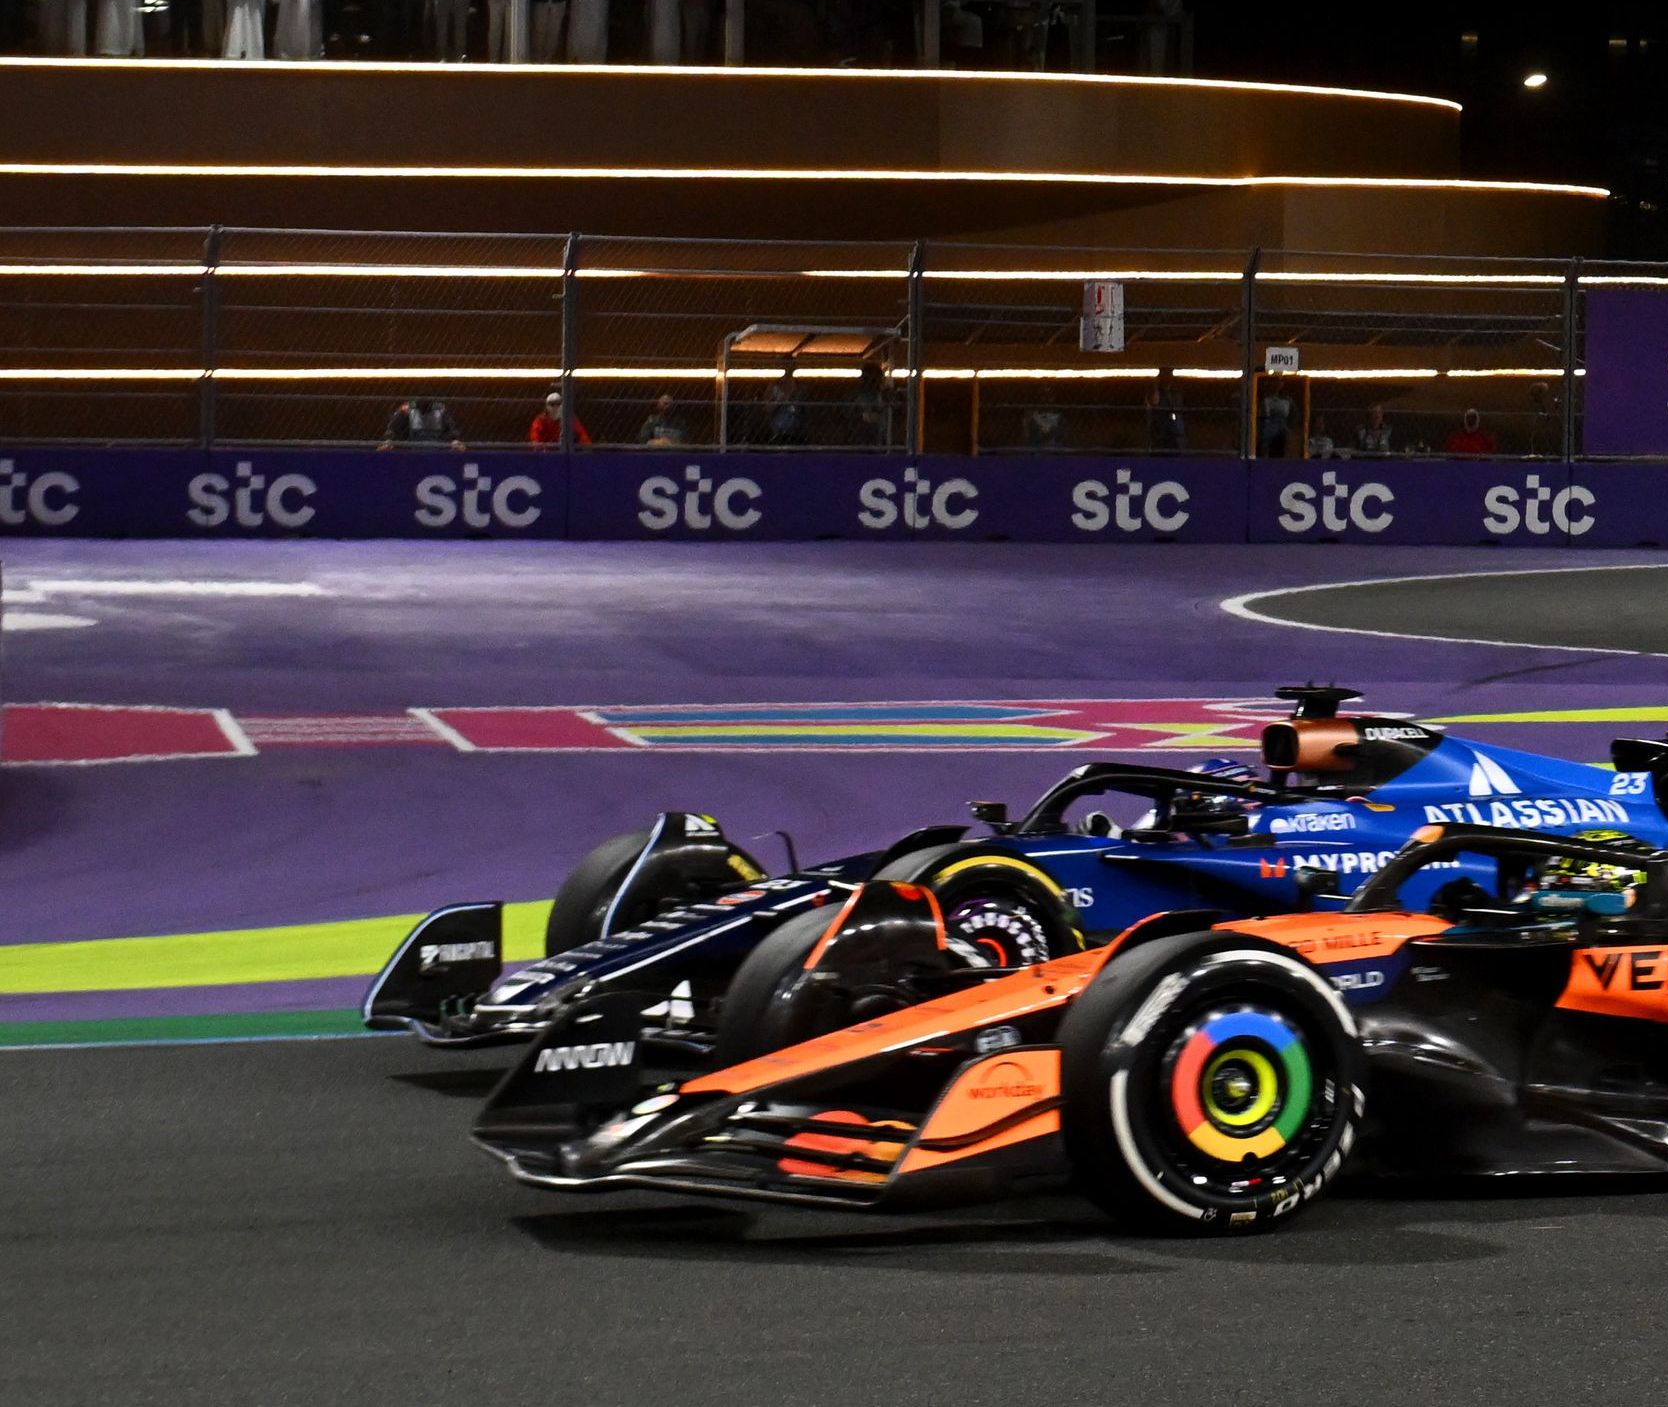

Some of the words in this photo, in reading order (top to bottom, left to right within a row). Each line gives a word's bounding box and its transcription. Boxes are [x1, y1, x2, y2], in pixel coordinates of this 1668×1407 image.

[1270, 354, 1294, 366] MP01
[0, 459, 80, 526] tc
[187, 461, 317, 527] stc
[414, 463, 542, 528] stc
[638, 465, 763, 530] stc
[858, 467, 980, 530] stc
[1071, 469, 1190, 532] stc
[1278, 471, 1395, 533] stc
[1483, 474, 1596, 536] stc
[1364, 726, 1430, 741] DURACELL
[1608, 771, 1649, 795] 23
[1424, 798, 1630, 830] ATLASSIAN
